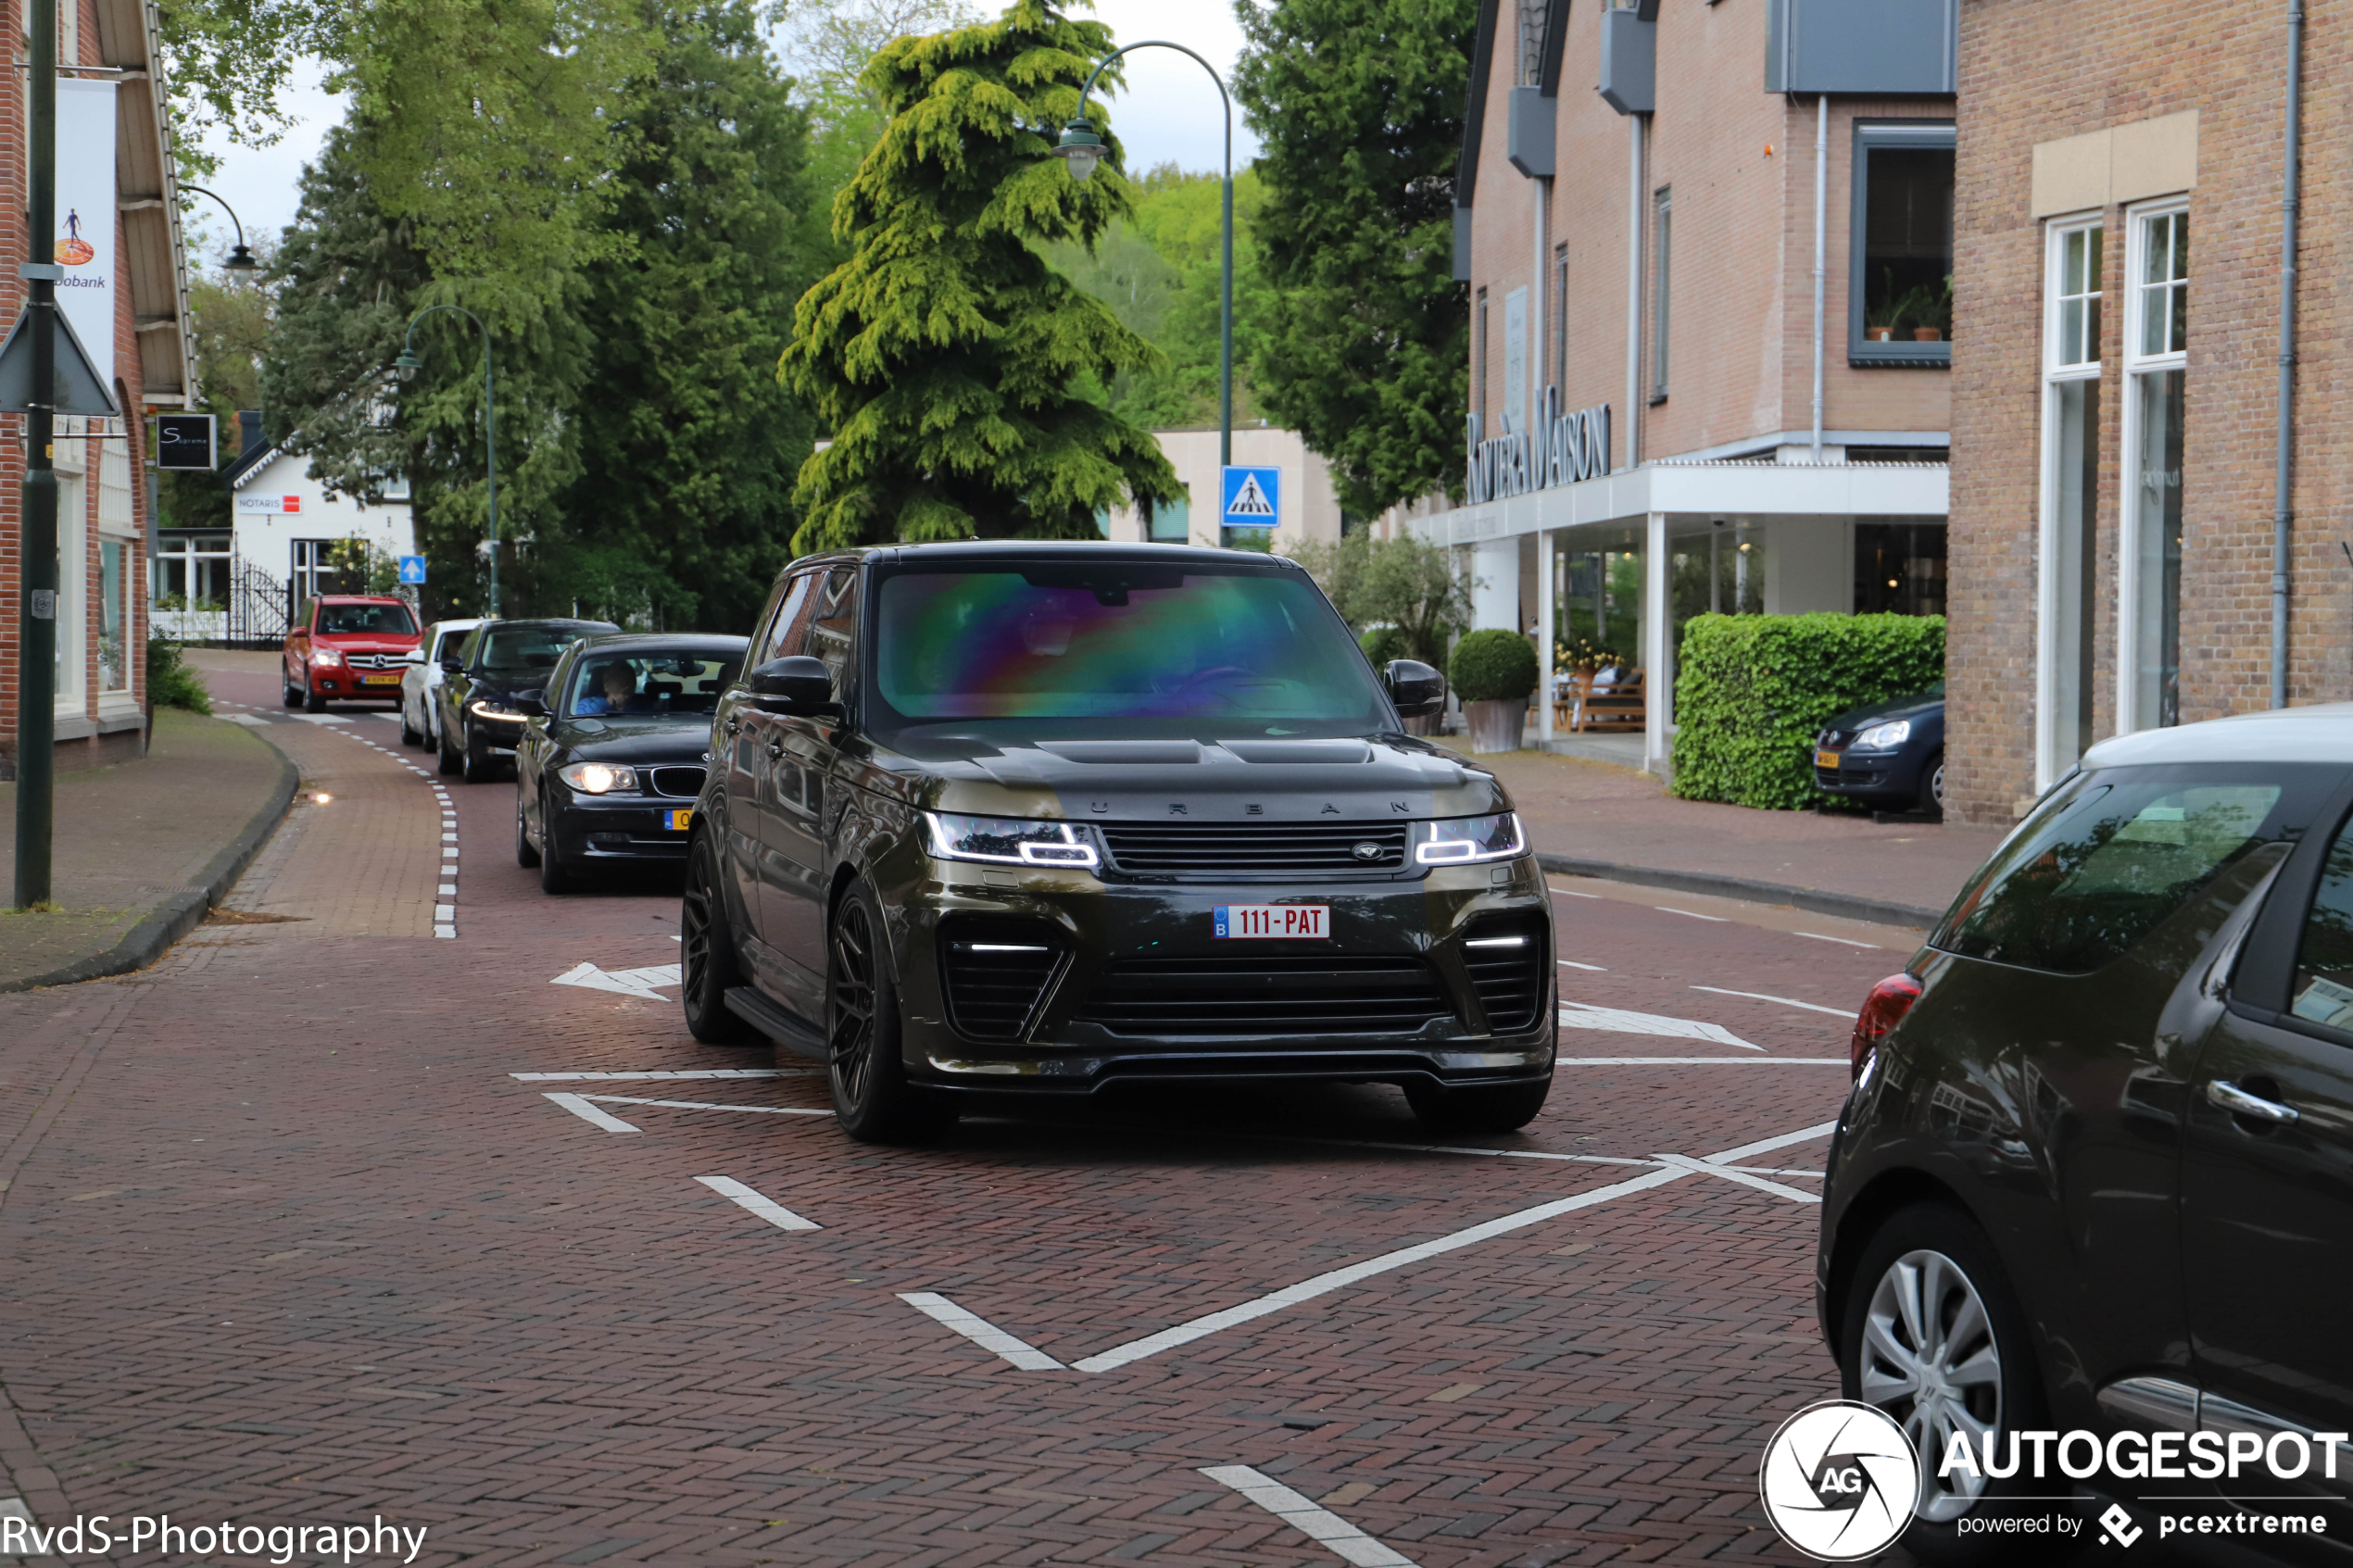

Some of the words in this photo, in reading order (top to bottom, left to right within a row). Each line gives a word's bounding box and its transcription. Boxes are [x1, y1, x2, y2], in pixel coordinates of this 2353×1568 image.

[1531, 384, 1611, 489] MAISON
[239, 498, 280, 508] NOTARIS
[1091, 800, 1409, 815] URBAN
[1216, 923, 1227, 936] B
[1240, 909, 1322, 935] 111-PAT
